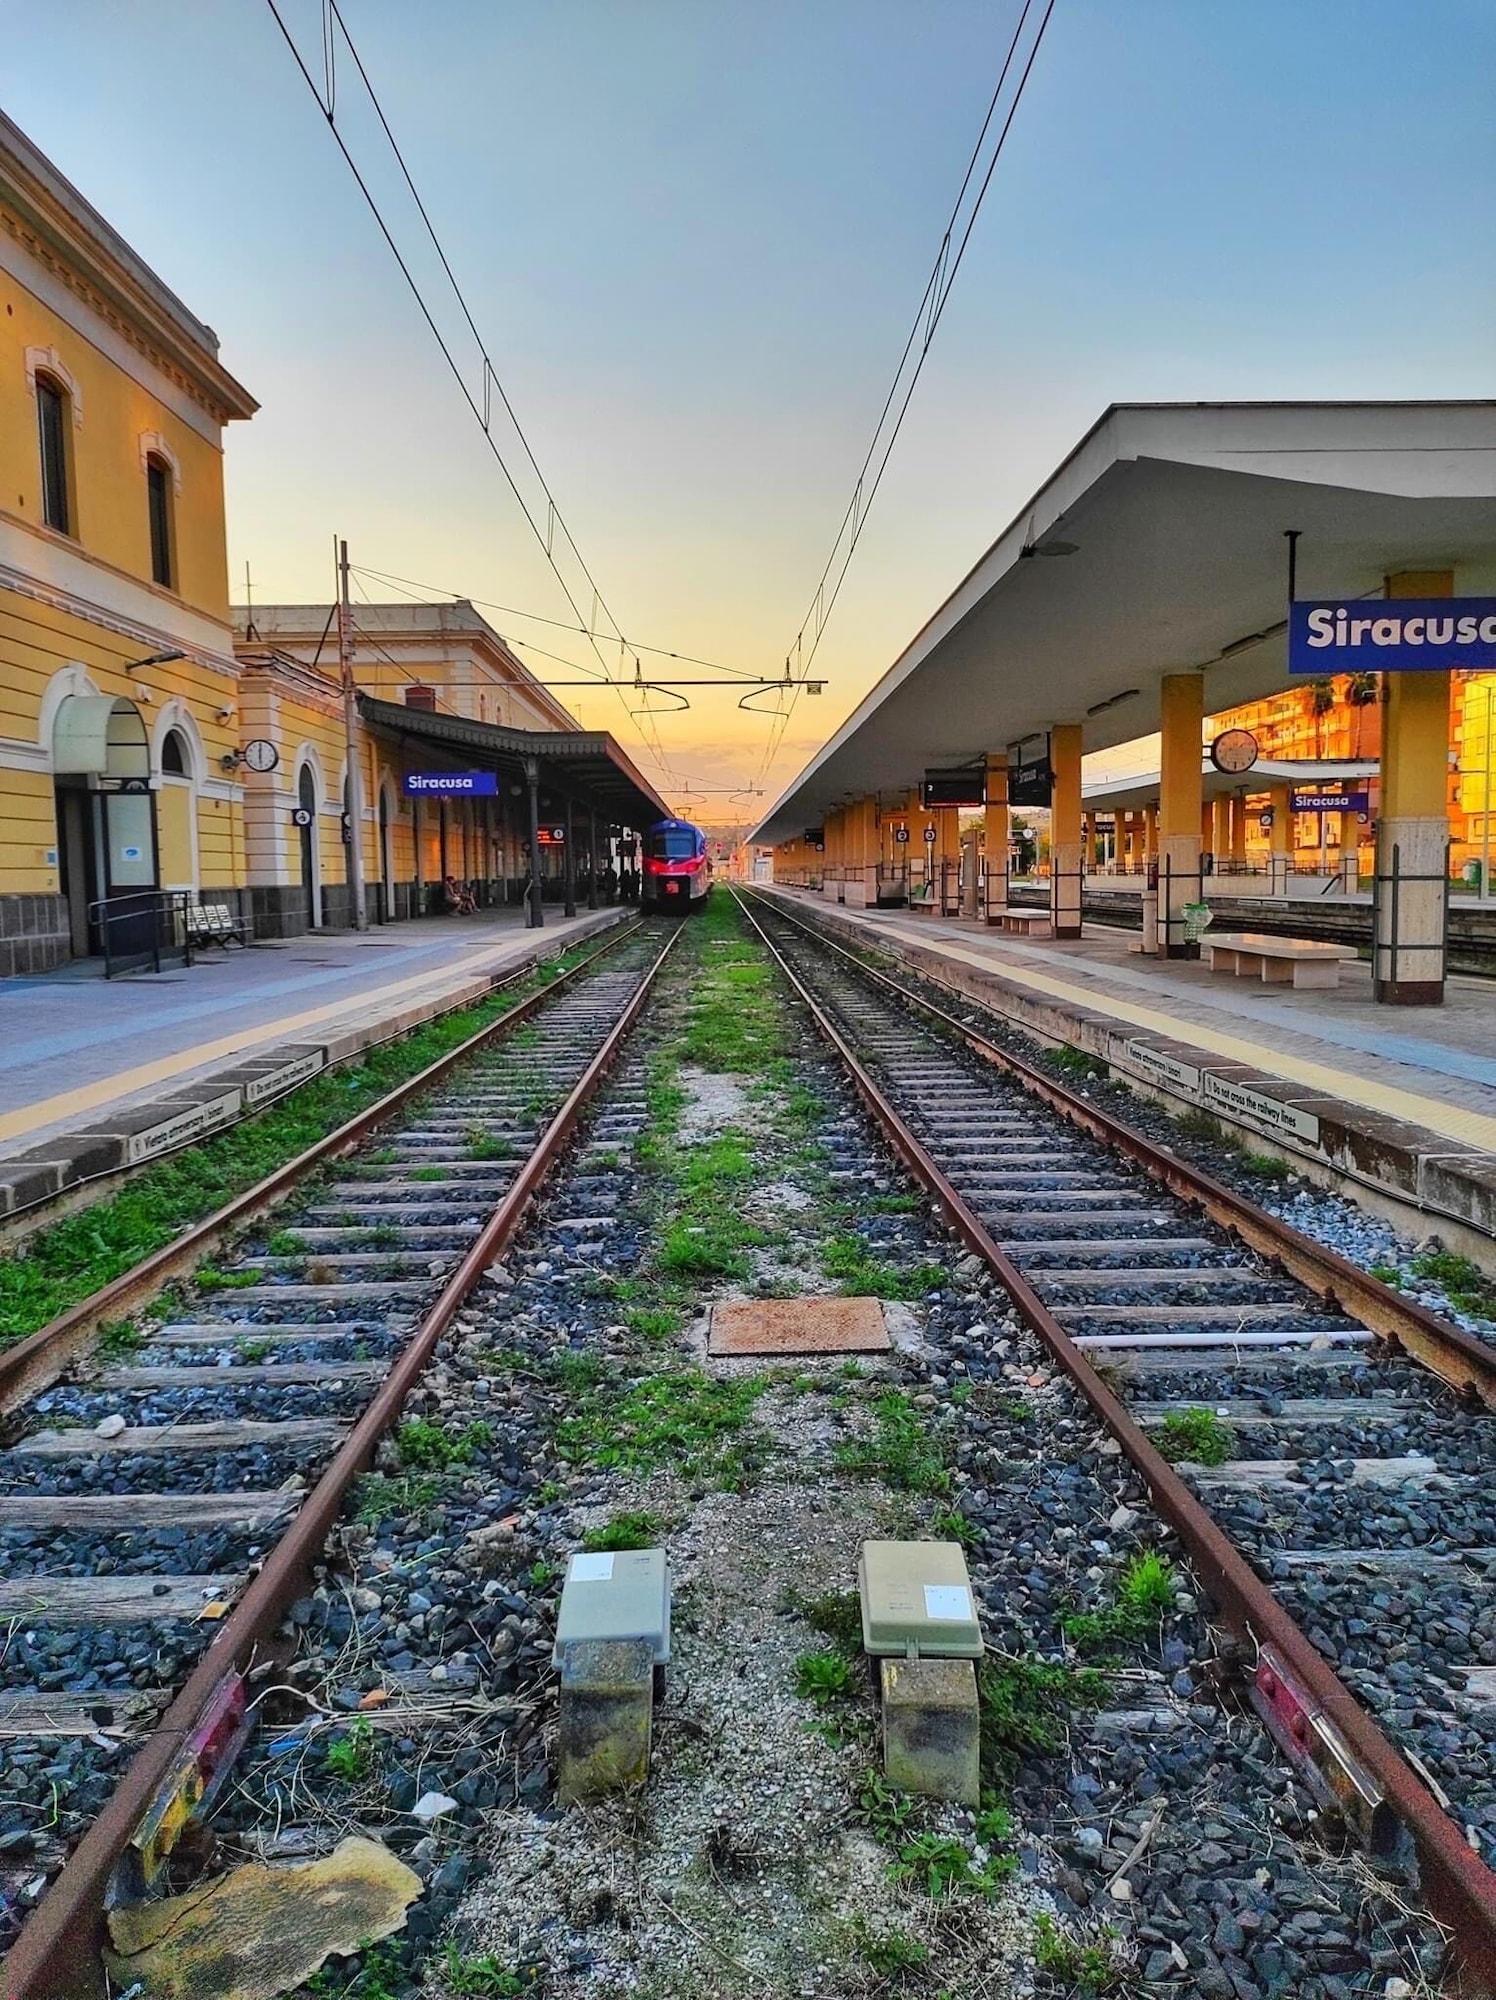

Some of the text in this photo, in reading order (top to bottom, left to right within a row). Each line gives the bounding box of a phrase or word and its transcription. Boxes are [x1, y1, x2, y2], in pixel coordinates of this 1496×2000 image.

[1307, 608, 1496, 648] Siracusa
[408, 776, 473, 789] Siracusa
[1295, 796, 1349, 807] Siracusa
[1213, 1082, 1296, 1127] Do not cross the railway lines
